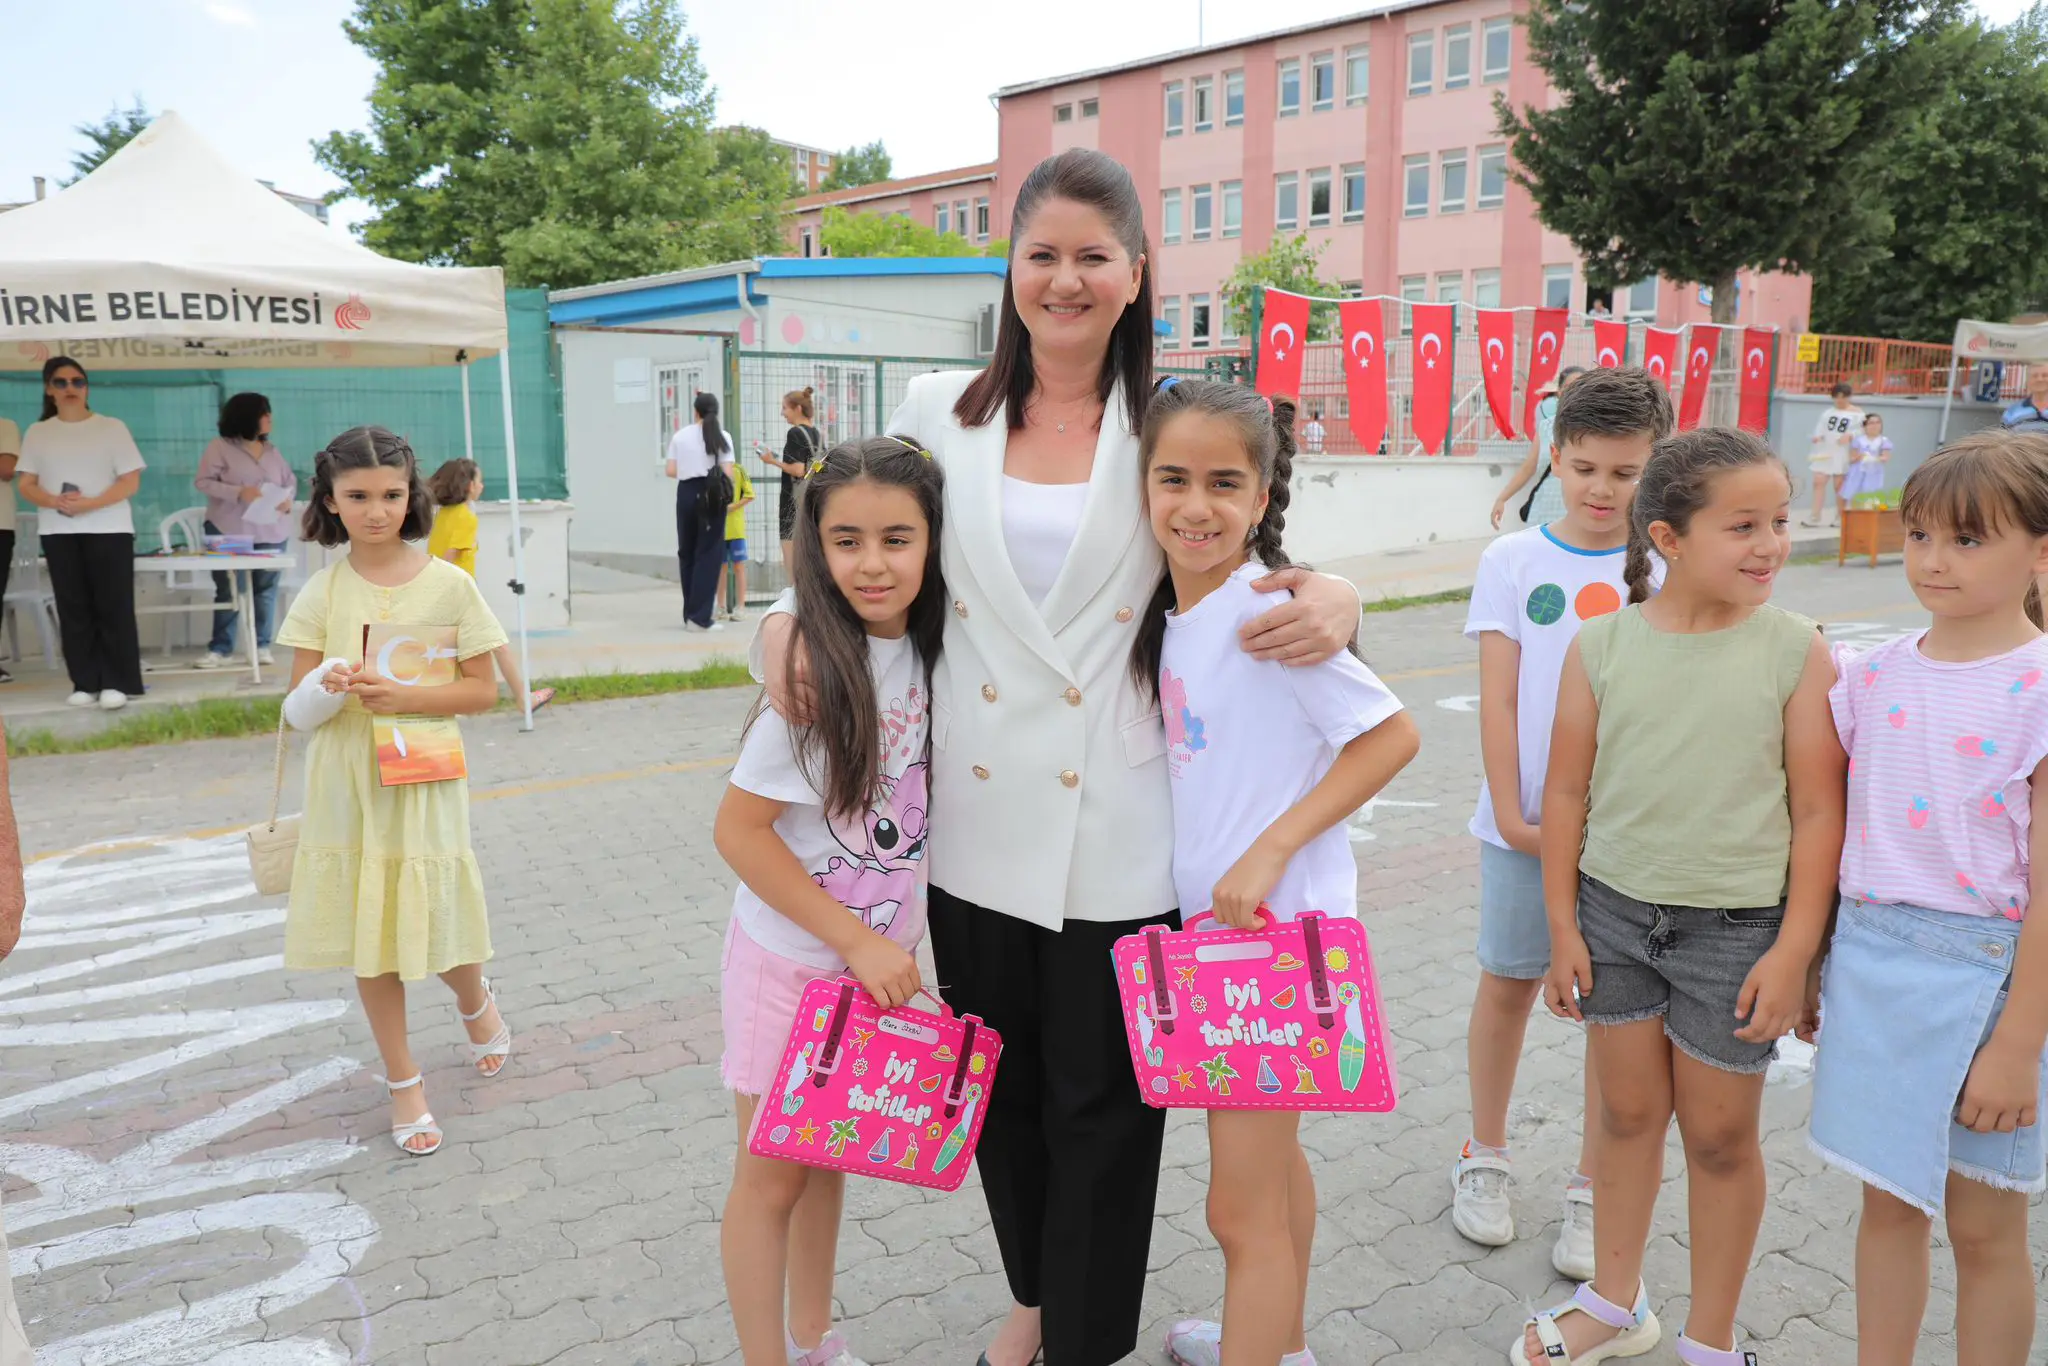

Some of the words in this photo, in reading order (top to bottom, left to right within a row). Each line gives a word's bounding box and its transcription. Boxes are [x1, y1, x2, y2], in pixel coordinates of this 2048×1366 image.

[107, 288, 322, 325] BELEDİYESİ
[1978, 361, 1994, 396] P
[1827, 415, 1850, 433] 98
[1222, 977, 1262, 1012] iyi
[1200, 1012, 1303, 1048] tatiller
[883, 1050, 918, 1085] iyi
[847, 1083, 932, 1128] tatiller
